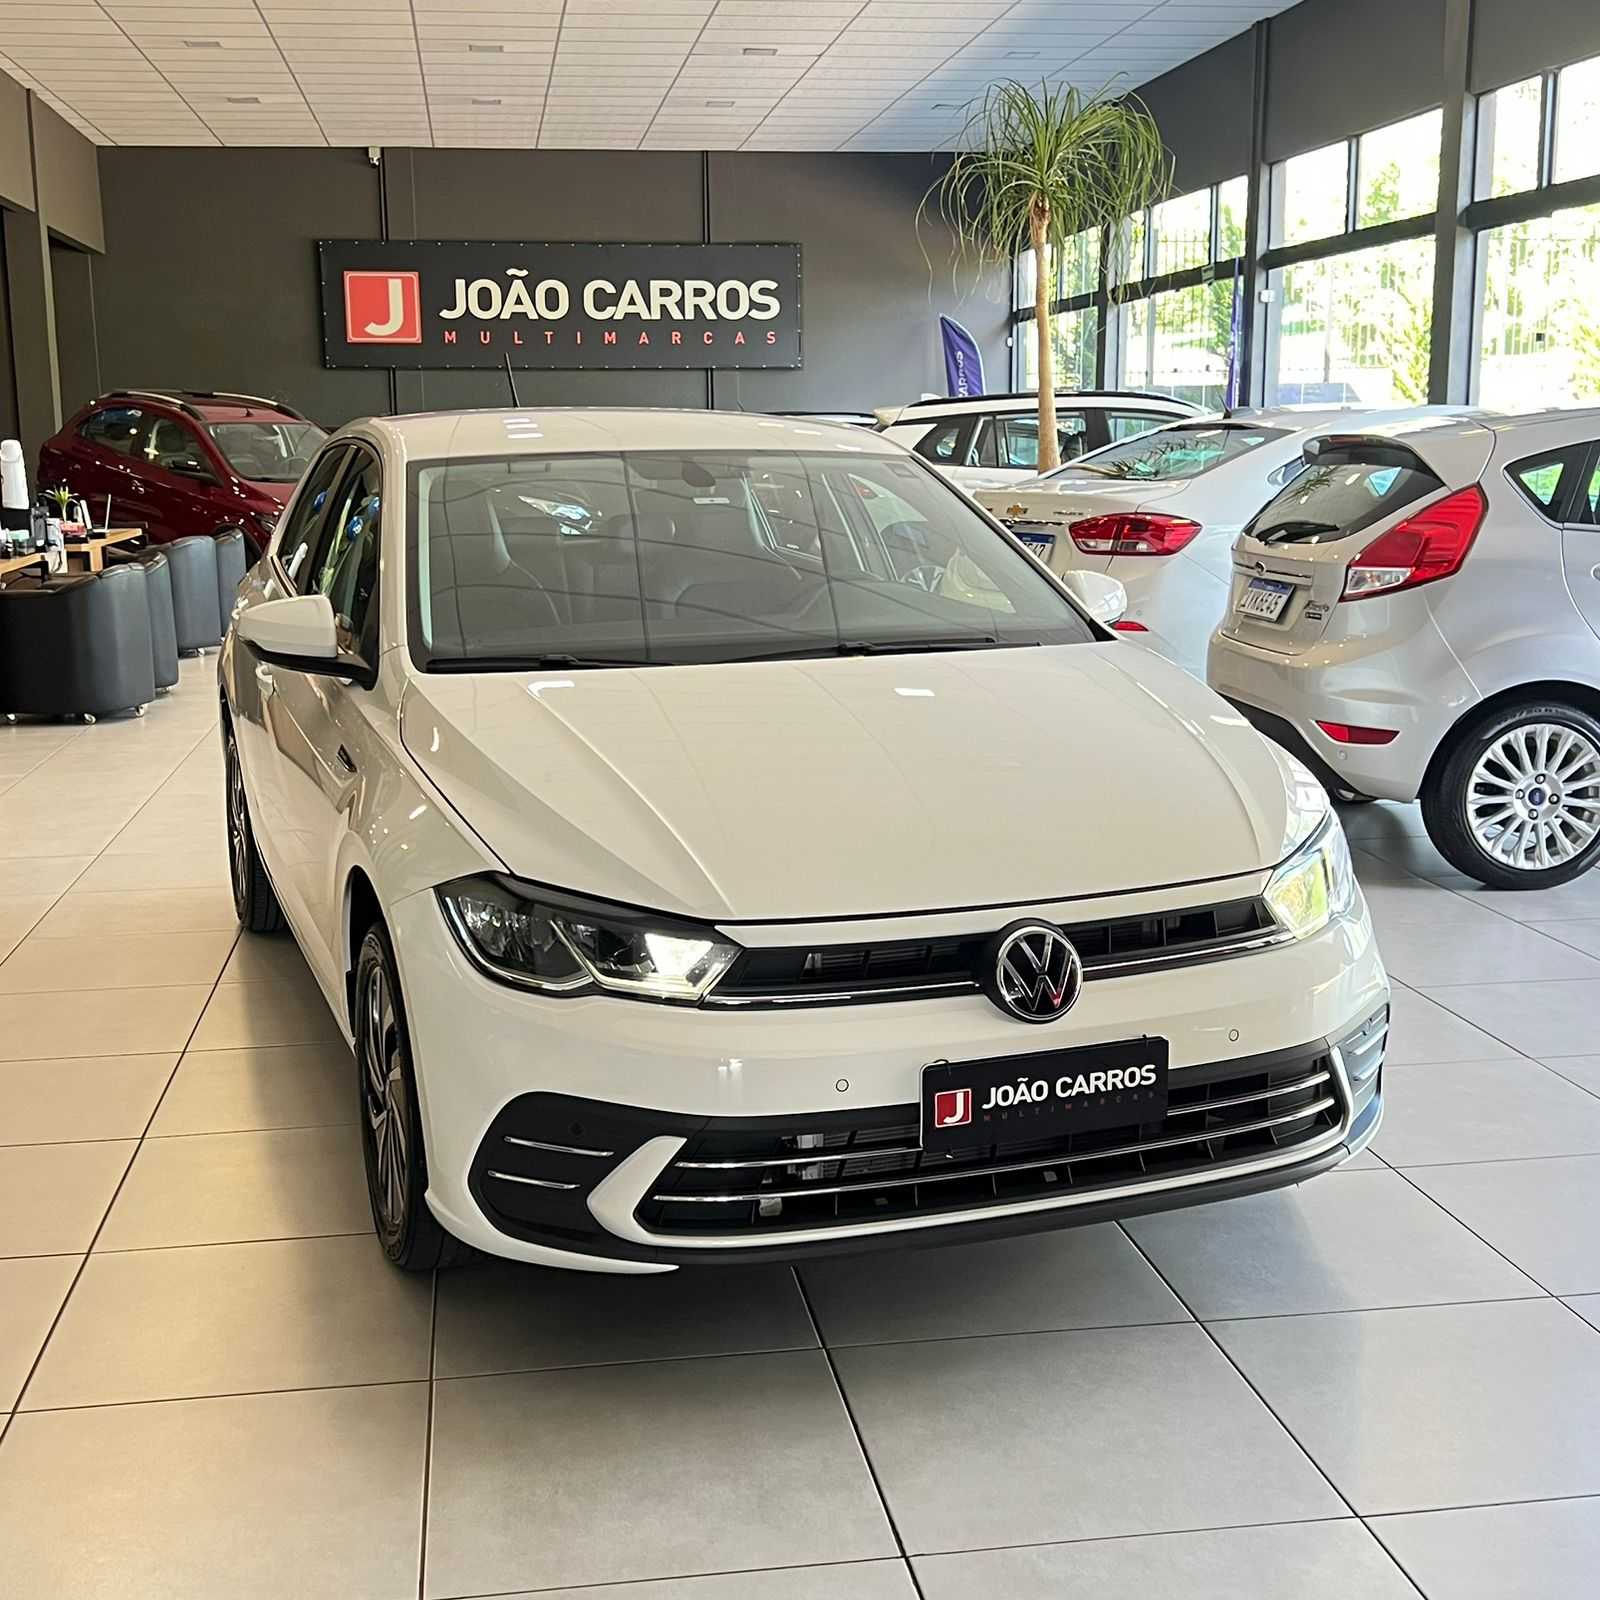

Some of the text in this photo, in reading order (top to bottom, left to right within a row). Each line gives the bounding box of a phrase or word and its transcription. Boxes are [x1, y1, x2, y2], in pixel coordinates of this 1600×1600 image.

[364, 278, 404, 336] J
[439, 267, 780, 320] JOÃO CARROS
[444, 329, 777, 345] MULTIMARCAS
[943, 1091, 964, 1124] J
[981, 1064, 1157, 1109] JOÃO CARROS
